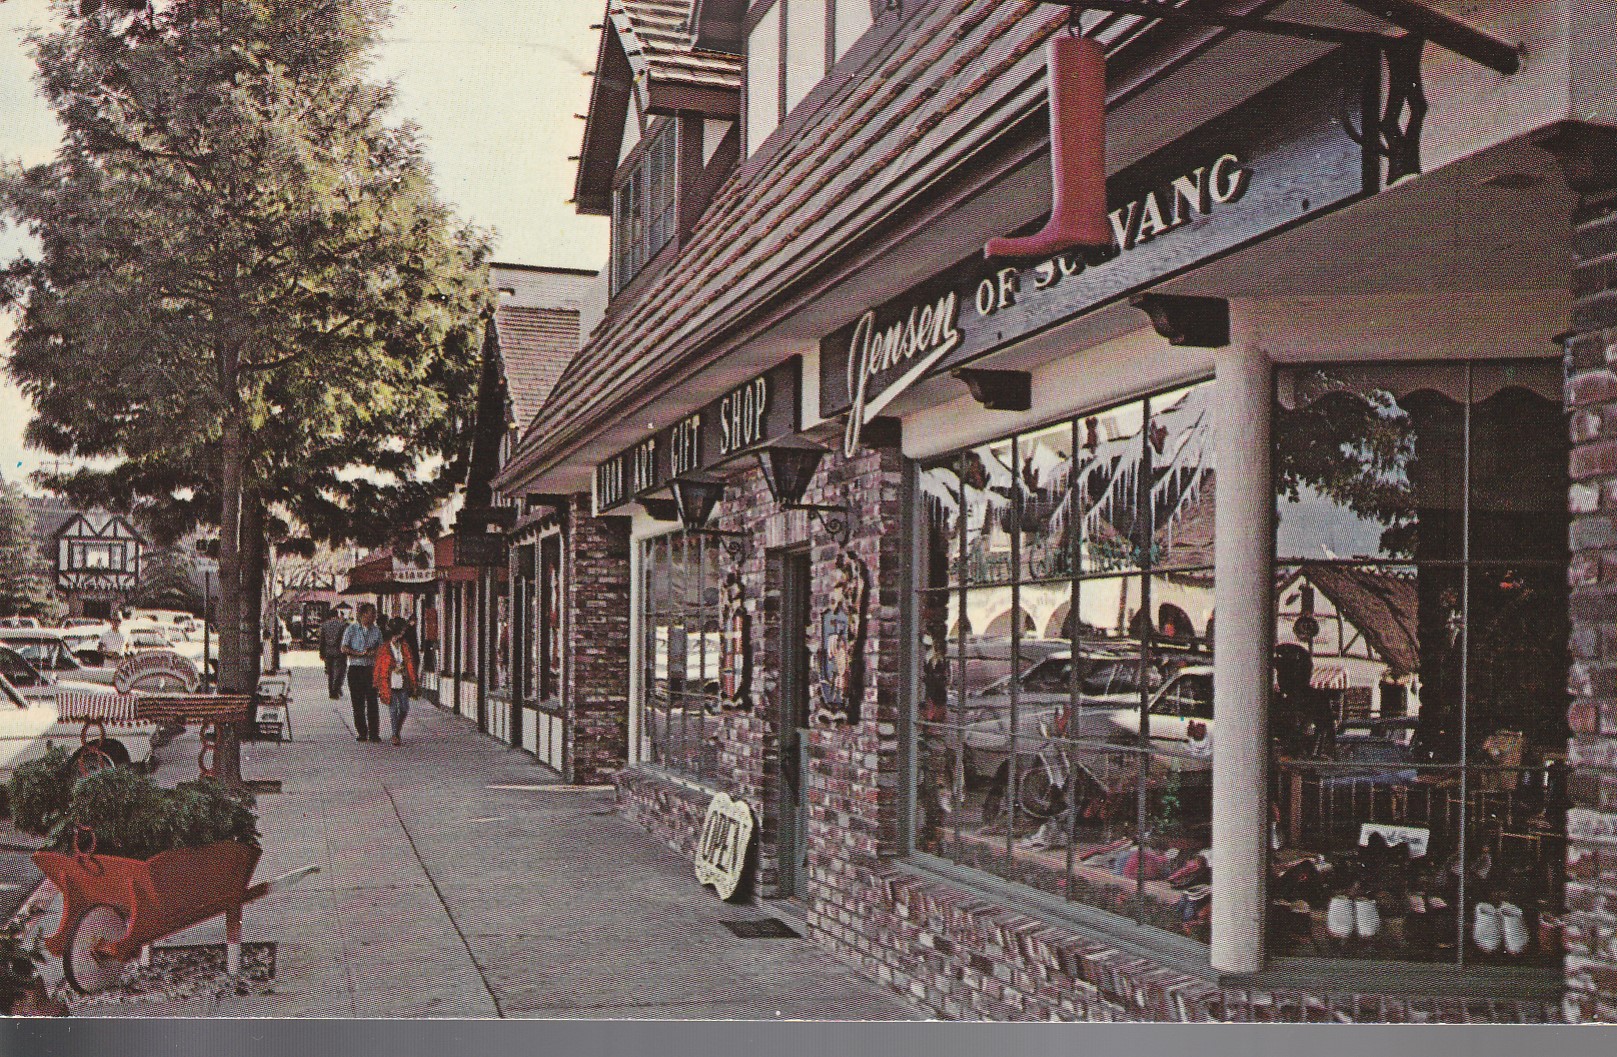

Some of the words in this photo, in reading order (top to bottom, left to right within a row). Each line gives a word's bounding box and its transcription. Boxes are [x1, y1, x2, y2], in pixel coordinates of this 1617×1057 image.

[844, 291, 959, 458] Jensen
[976, 267, 1017, 316] OF
[633, 438, 656, 494] ART
[671, 413, 700, 479] GIFT
[720, 376, 767, 455] SHOP
[702, 809, 748, 876] OPEN
